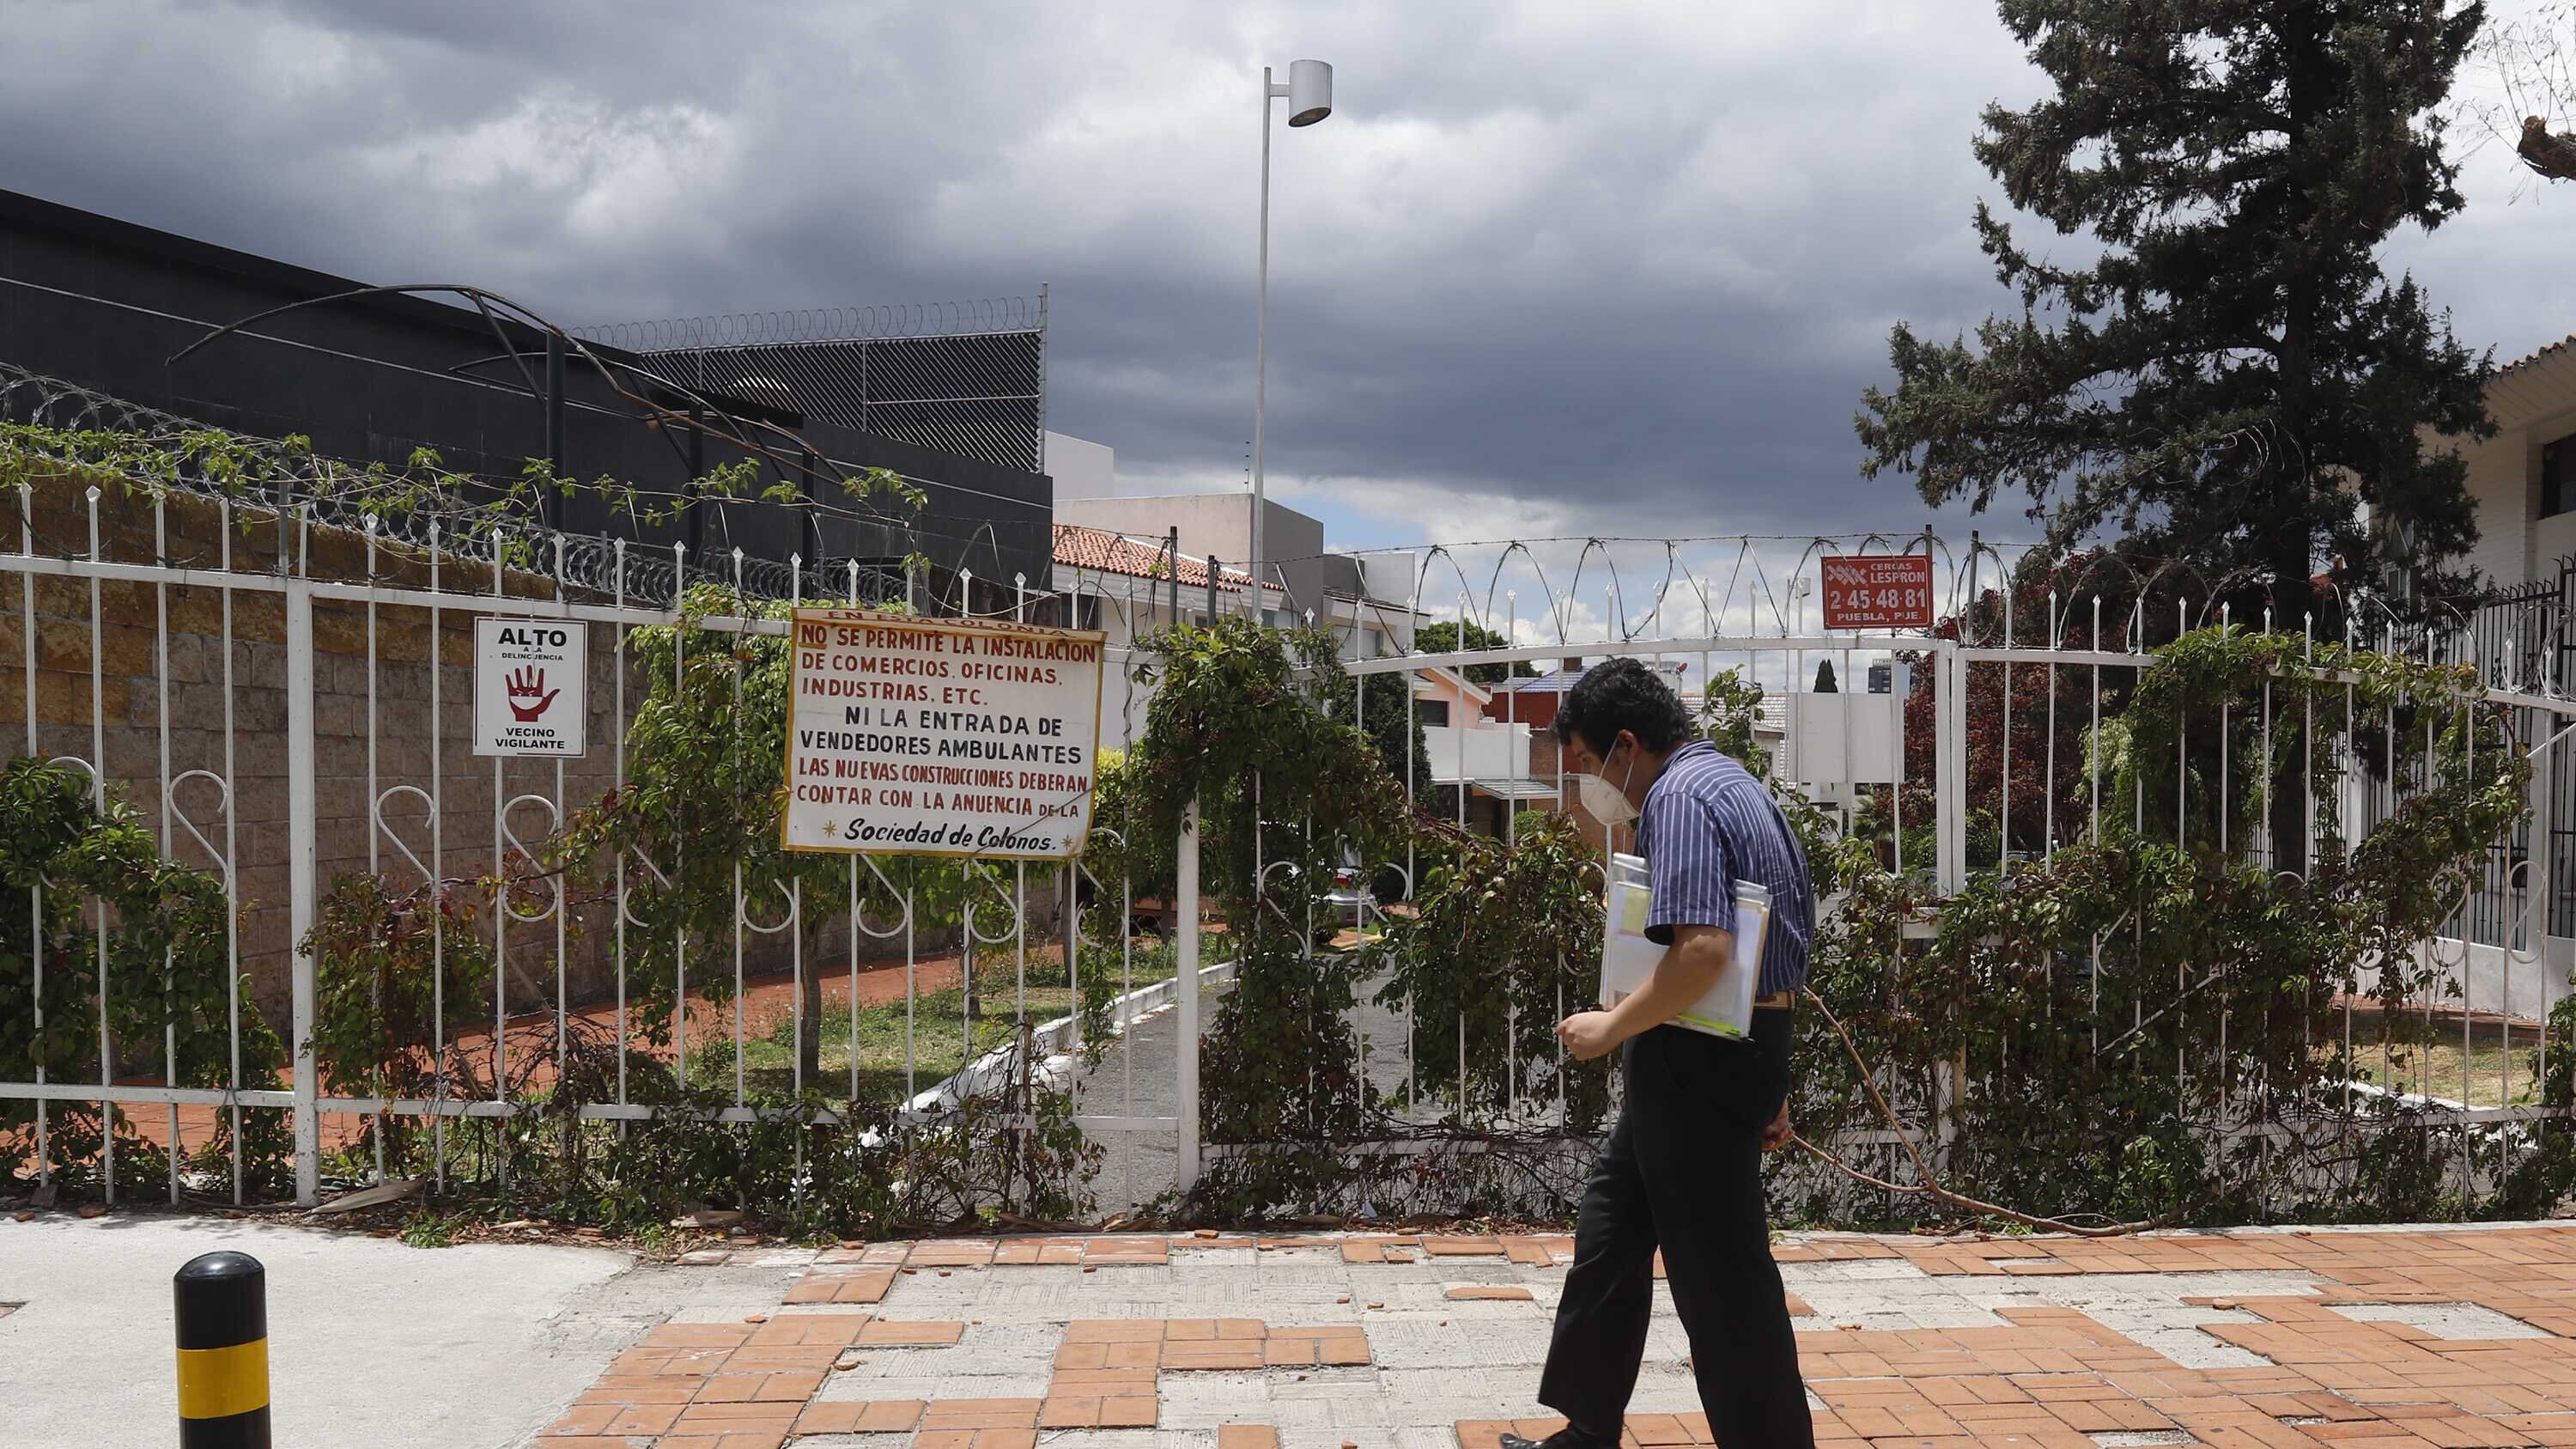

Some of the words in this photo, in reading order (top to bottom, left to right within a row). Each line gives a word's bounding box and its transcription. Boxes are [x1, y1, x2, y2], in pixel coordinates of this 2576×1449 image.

[1870, 571, 1924, 583] LESPRON
[1838, 612, 1889, 622] PUEBLA,
[945, 619, 1070, 636] COLONIA
[498, 628, 567, 647] ALTO
[801, 624, 827, 644] NO
[836, 629, 860, 647] SE
[866, 630, 944, 653] PERMITE
[952, 637, 975, 655] LA
[802, 653, 824, 671] DE
[944, 687, 987, 706] ETC.
[845, 707, 870, 726] NI
[880, 709, 908, 728] LA
[920, 710, 1030, 735] ENTRADA
[1039, 718, 1061, 737] DE
[506, 728, 555, 737] VECINO
[495, 739, 565, 748] VIGILANTE
[801, 730, 931, 756] VENDEDORES
[938, 740, 1081, 764] AMBULANTES
[799, 758, 829, 777] LAS
[835, 759, 898, 782] NUEVAS
[902, 764, 1012, 788] CONSTRUCCIONES
[1019, 772, 1087, 792] DEBERAN
[797, 785, 872, 806] CONTAR
[880, 789, 913, 807] CON
[924, 792, 944, 810] LA
[952, 795, 1031, 816] ANUENCIA
[1039, 804, 1054, 817] DE
[1060, 805, 1078, 818] LA
[844, 818, 945, 844] Sociedad
[949, 823, 973, 846] de
[977, 826, 1056, 851] Colonos.
